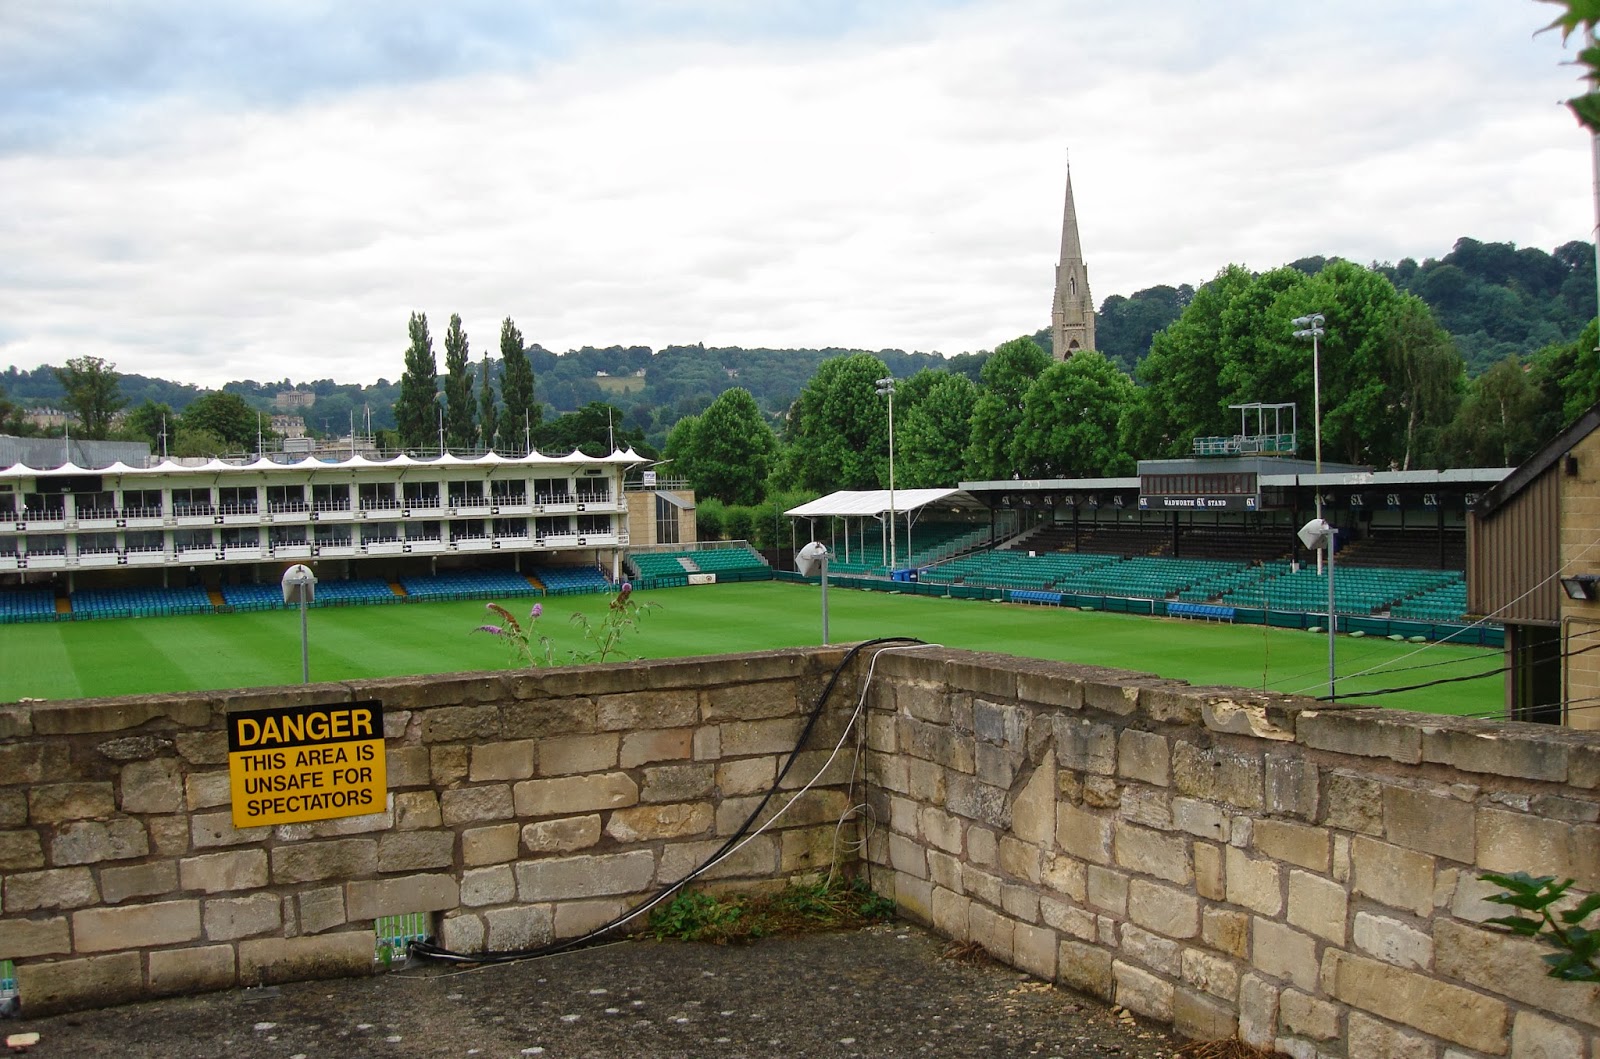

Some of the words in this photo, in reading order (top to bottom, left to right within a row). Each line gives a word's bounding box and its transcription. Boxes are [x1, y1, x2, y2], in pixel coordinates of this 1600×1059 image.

[1197, 498, 1205, 506] 6X
[1207, 499, 1227, 507] STAND
[1246, 498, 1254, 506] 6X
[237, 709, 373, 746] DANGER
[240, 753, 286, 772] THIS
[295, 747, 348, 767] AREA
[356, 744, 375, 761] IS
[244, 771, 324, 794] UNSAFE
[333, 767, 373, 785] FOR
[247, 788, 373, 816] SPECTATORS
